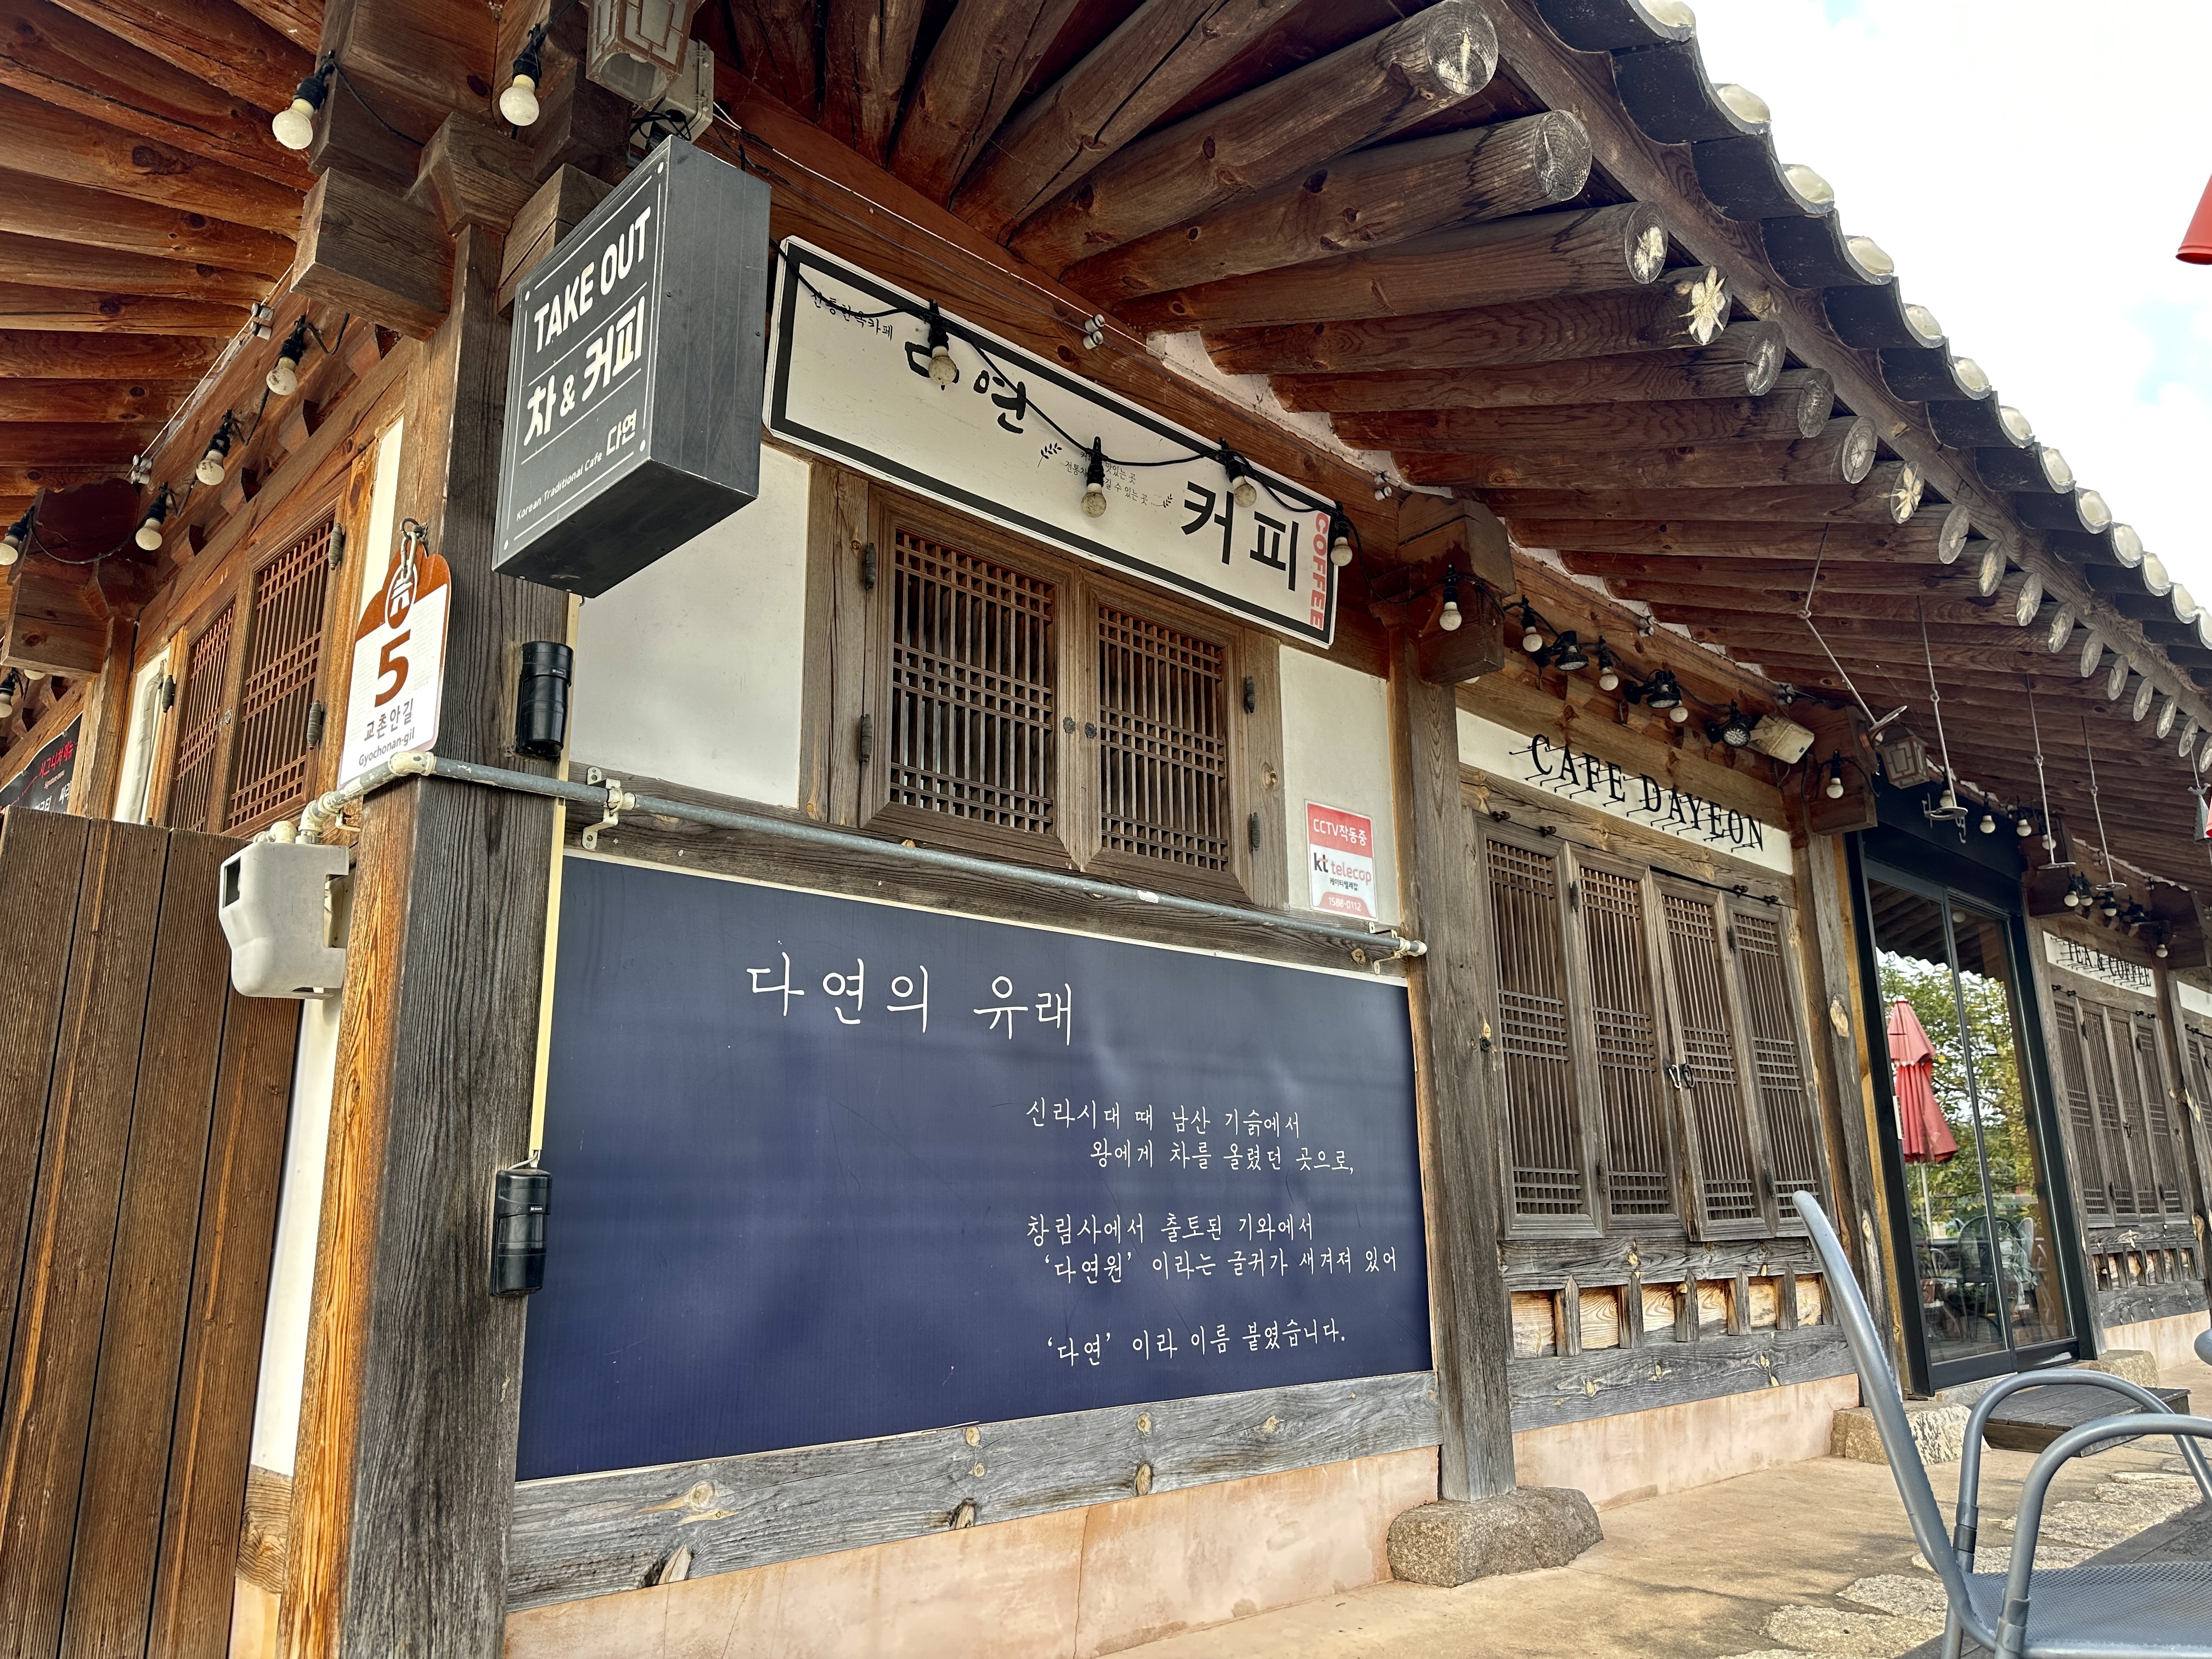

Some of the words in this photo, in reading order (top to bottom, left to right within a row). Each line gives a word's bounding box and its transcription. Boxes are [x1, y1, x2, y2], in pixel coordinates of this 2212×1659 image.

[534, 261, 594, 353] TAKE
[601, 206, 651, 296] OUT
[523, 375, 556, 446] 차
[560, 374, 575, 417] &
[582, 296, 645, 401] 커피
[606, 409, 636, 456] 다연
[516, 498, 541, 521] Korean
[544, 464, 583, 501] Traditional
[585, 452, 602, 472] Cafe
[1114, 483, 1121, 492] 수
[1125, 487, 1138, 501] 있는
[1141, 494, 1148, 505] 곳
[1128, 473, 1136, 484] 곳
[1181, 481, 1299, 592] 커피
[1310, 512, 1329, 629] COFFEE
[374, 629, 411, 708] 5
[364, 698, 414, 741] 교촌안길
[359, 727, 415, 767] Gyochonan-gil
[1531, 734, 1626, 803] CAFE
[1640, 774, 1763, 851] DAYEON
[1313, 819, 1367, 846] CCTV작동중
[1313, 853, 1328, 873] kt
[1331, 862, 1372, 885] telecop
[1328, 896, 1361, 911] 1588-0112
[2064, 937, 2093, 968] TEA
[2096, 948, 2105, 972] &
[2108, 954, 2151, 987] COFFEE
[747, 951, 928, 1033] 다연의
[974, 975, 1071, 1046] 유래
[1026, 1097, 1120, 1130] 신라시대
[1135, 1104, 1153, 1131] 때
[1172, 1105, 1211, 1135] 남산
[1225, 1108, 1299, 1138] 기슭에서
[1090, 1138, 1153, 1168] 왕에게
[1170, 1141, 1212, 1169] 차를
[1223, 1143, 1281, 1170] 올렸던
[1296, 1147, 1353, 1175] 곳으로,
[1027, 1212, 1143, 1247] 창림사에서
[1161, 1212, 1221, 1243] 출토된
[1239, 1212, 1312, 1241] 기와에서
[1153, 1250, 1216, 1280] 이라는
[1227, 1248, 1288, 1277] 글귀가
[1299, 1247, 1351, 1275] 새겨져
[1365, 1246, 1396, 1272] 있어
[1132, 1328, 1178, 1361] 이라
[1191, 1324, 1230, 1355] 이름
[1242, 1318, 1345, 1351] 붙였습니다.
